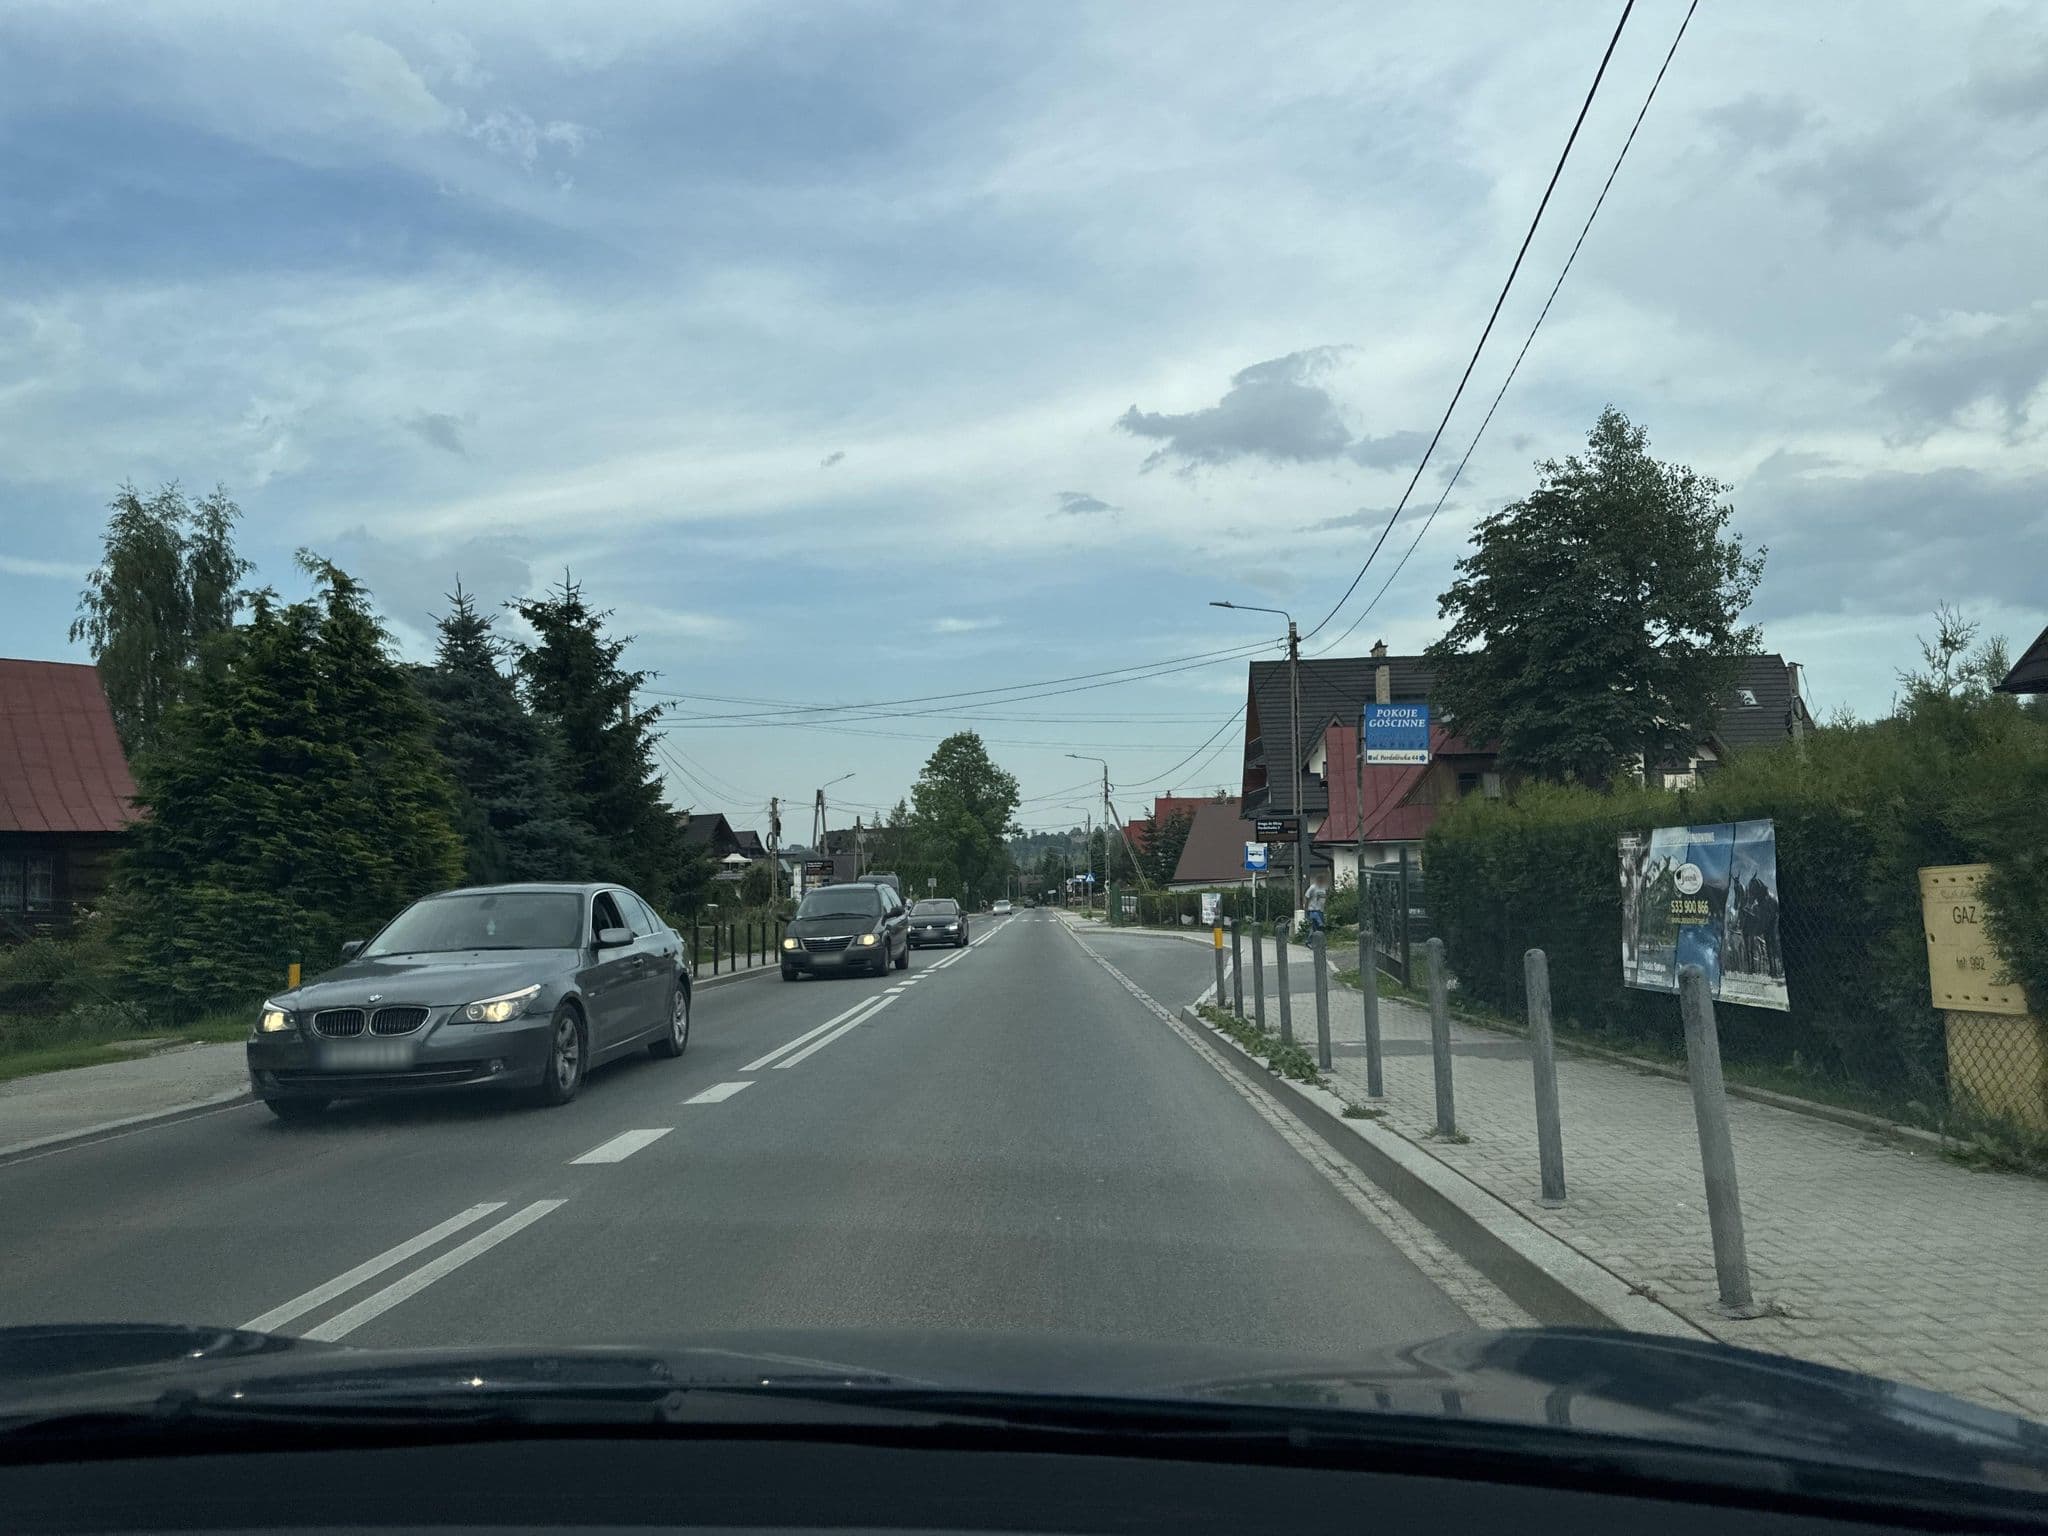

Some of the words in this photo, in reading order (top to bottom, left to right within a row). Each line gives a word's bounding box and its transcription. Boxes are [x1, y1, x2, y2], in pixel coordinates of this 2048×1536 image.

[1376, 709, 1418, 718] POKOJE
[1368, 718, 1426, 728] GOŚCINNE
[1672, 900, 1684, 914] 533
[1684, 900, 1696, 914] 900
[1697, 900, 1708, 914] 866
[1952, 906, 1978, 924] GAZ
[1970, 956, 1986, 970] 992
